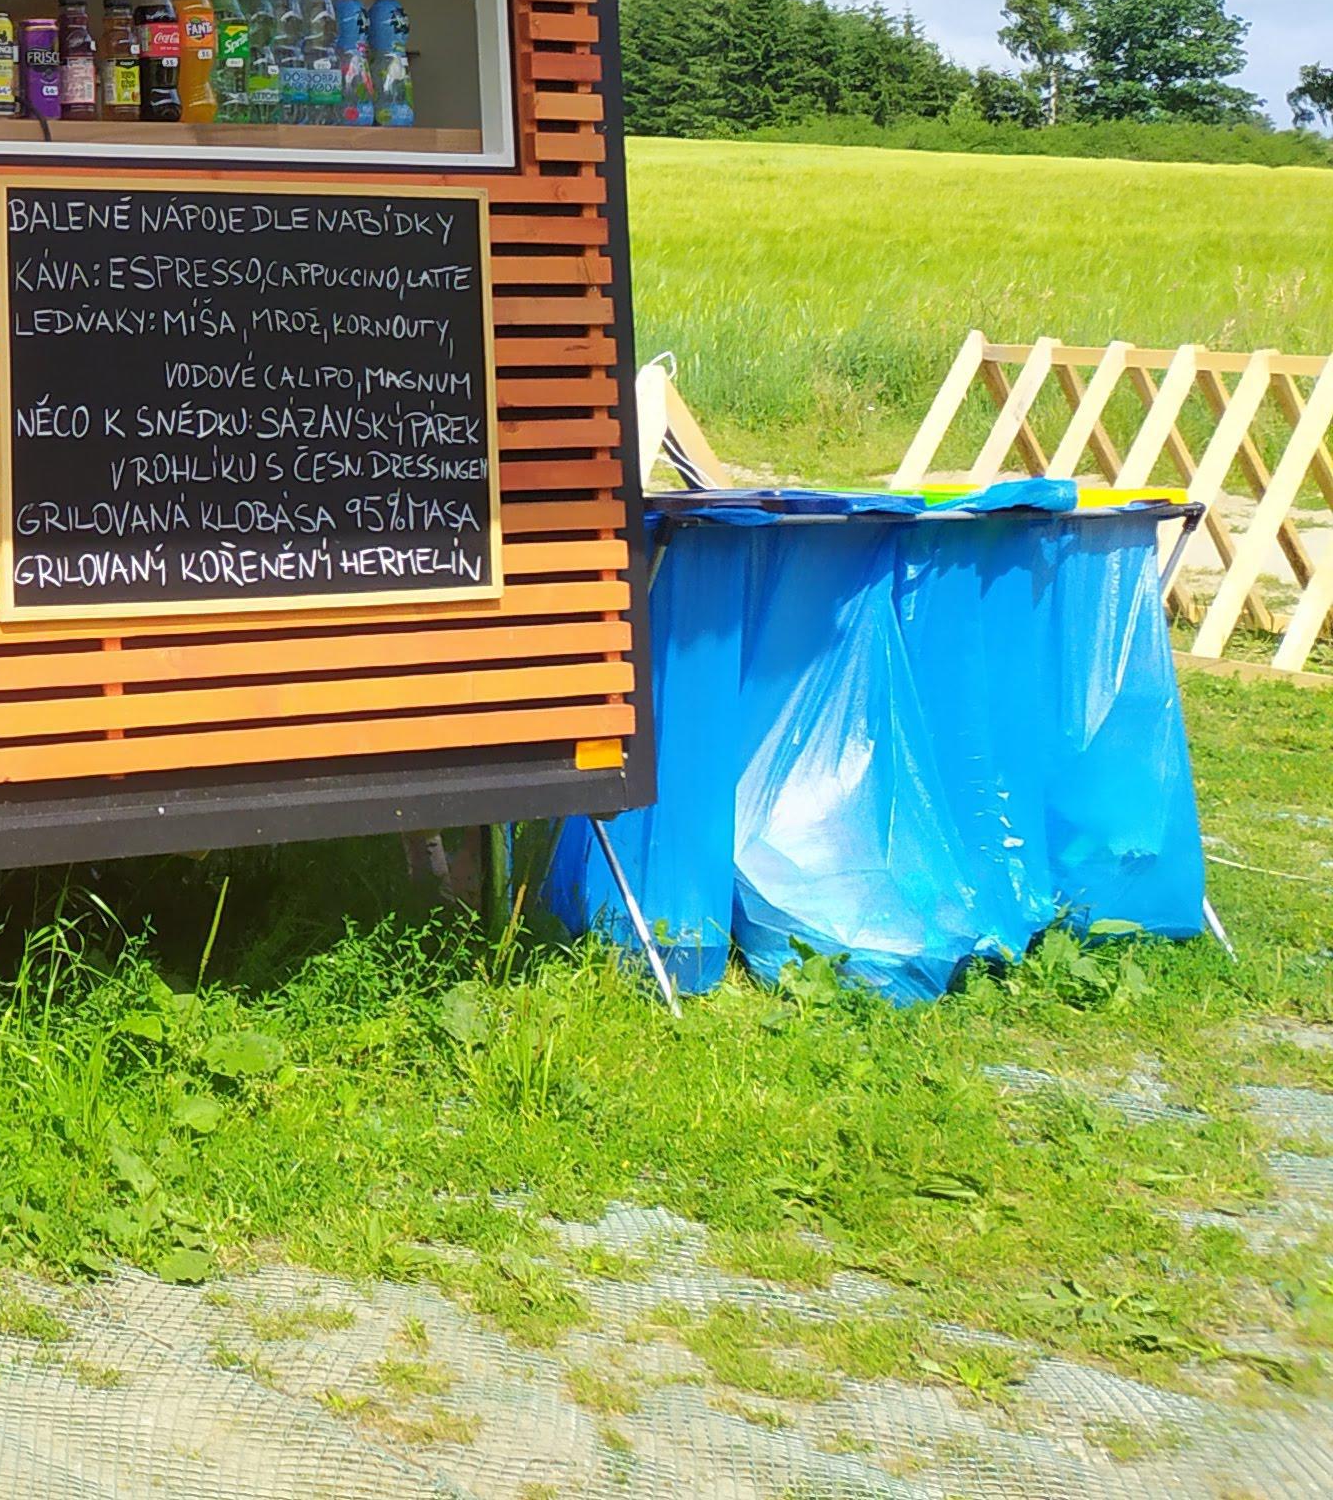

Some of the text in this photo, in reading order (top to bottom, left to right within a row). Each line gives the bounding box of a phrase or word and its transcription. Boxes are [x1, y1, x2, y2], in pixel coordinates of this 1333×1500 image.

[8, 196, 454, 246] BALENÉ NÁPOJE DLE NABÍDKY
[15, 248, 102, 292] KÁVA:
[406, 265, 473, 291] LATTE
[15, 303, 157, 336] LEDŇAKY:
[165, 350, 256, 389] VODOVÉ
[365, 366, 472, 401] MAGNUM
[105, 407, 126, 439] K
[403, 399, 480, 448] PÁREK
[110, 457, 126, 491] V
[129, 444, 257, 487] ROHLÍKU
[266, 452, 284, 481] S
[293, 445, 365, 483] ČESN.
[16, 487, 481, 537] GRILOVANÁ KLOBÁSA 95% MASA
[14, 537, 482, 589] GRILOVANÝ KOŘENĚNÝ HERMELÍN
